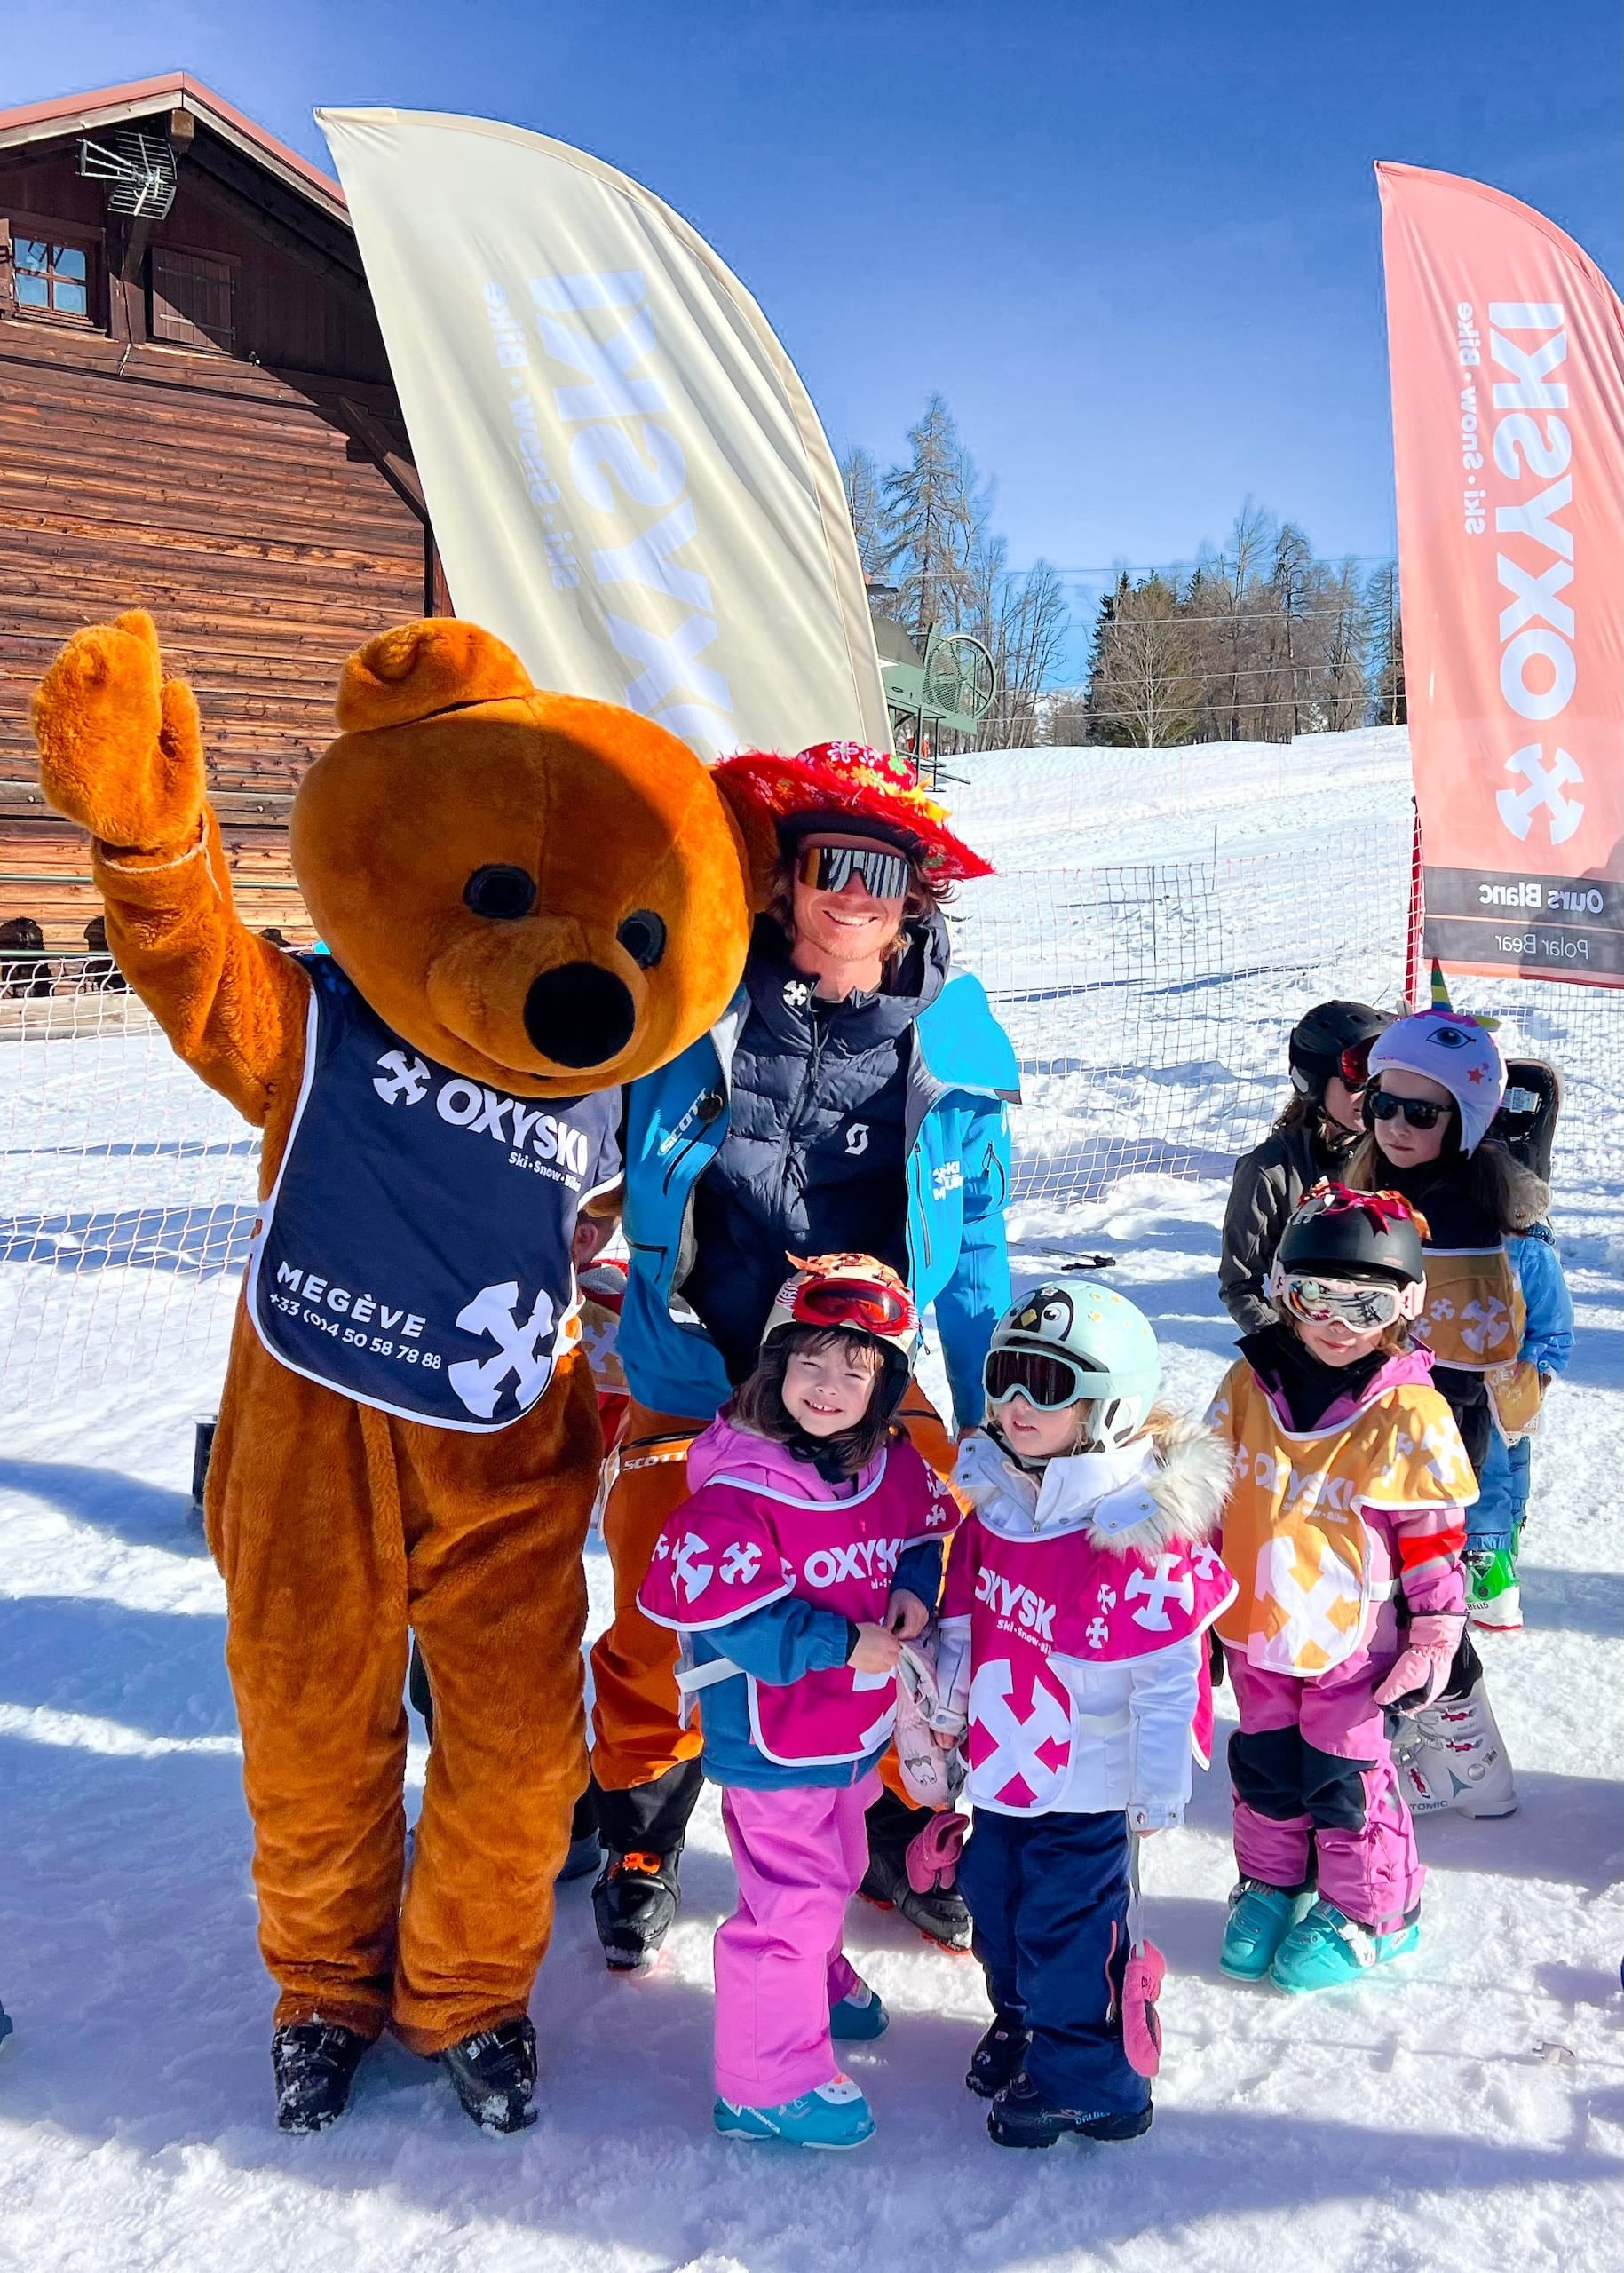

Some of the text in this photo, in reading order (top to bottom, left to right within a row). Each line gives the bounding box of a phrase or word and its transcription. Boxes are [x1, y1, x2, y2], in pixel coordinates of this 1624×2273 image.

[436, 1079, 588, 1176] OXYSKI
[508, 1152, 529, 1168] Ski
[533, 1160, 562, 1182] Snow
[277, 1261, 427, 1338] MEGÈVE
[269, 1293, 441, 1370] +33 (0)4 50 58 78 88
[622, 1451, 687, 1472] SCOTT
[996, 1619, 1014, 1633] Ski
[1017, 1627, 1039, 1648] Snow
[1410, 1800, 1448, 1811] TOMIC
